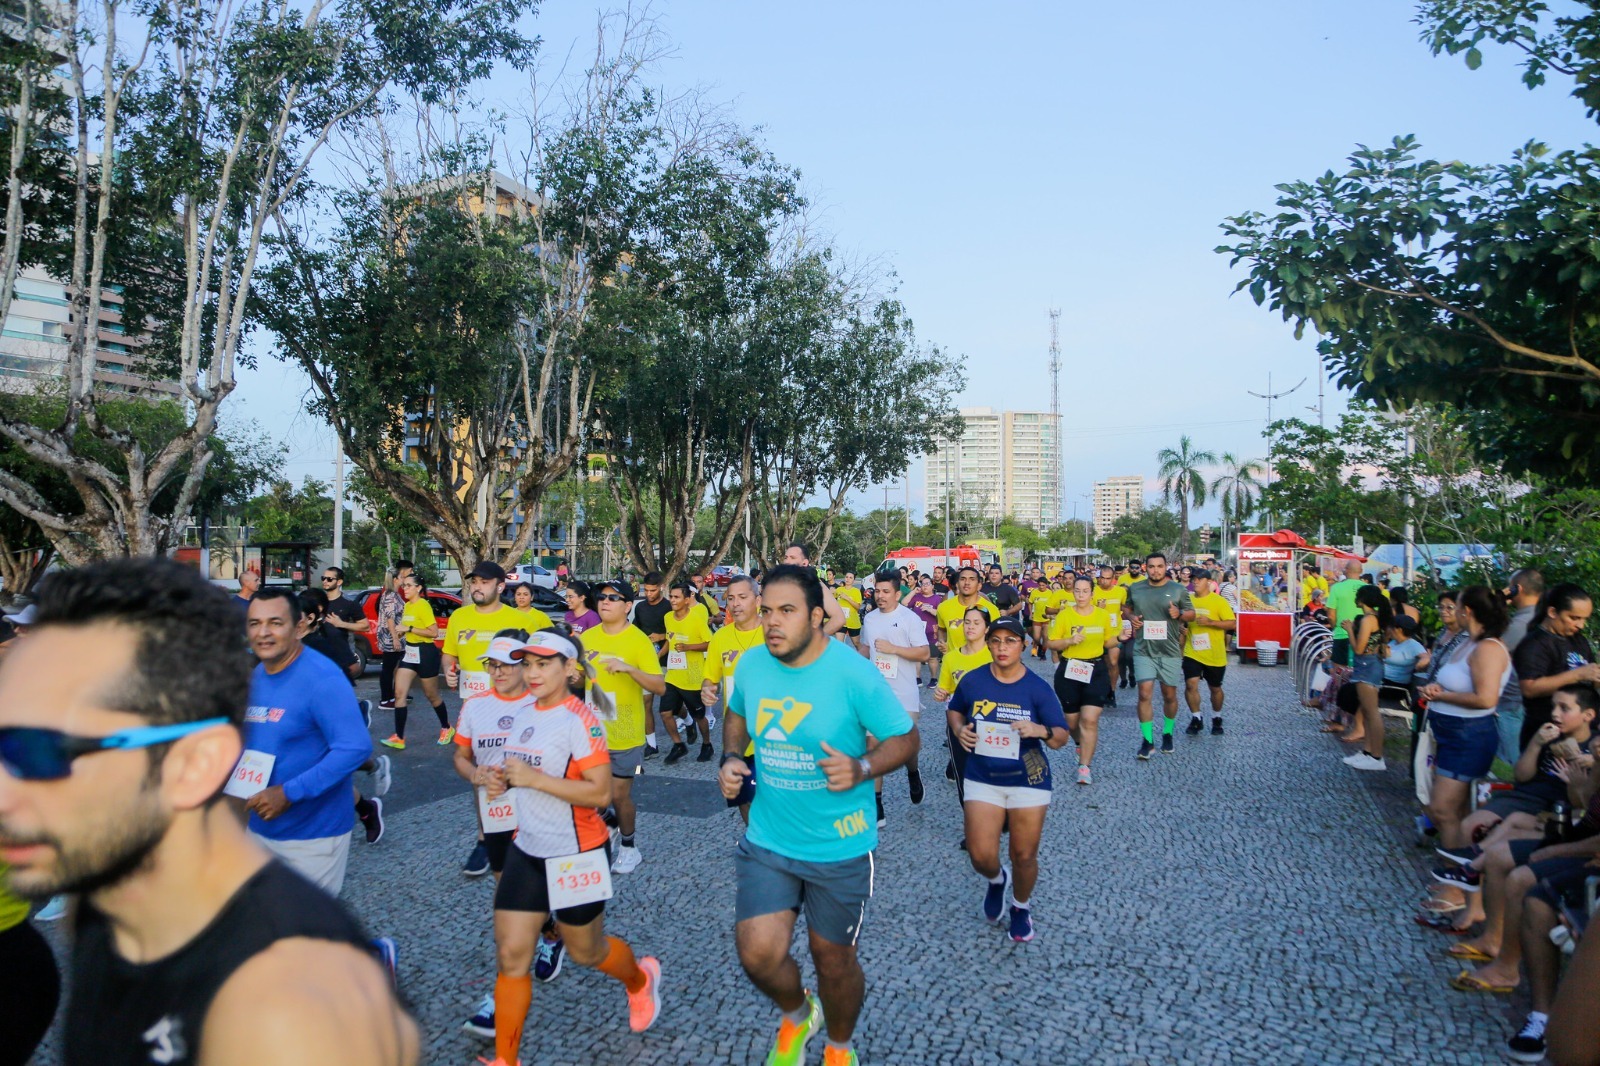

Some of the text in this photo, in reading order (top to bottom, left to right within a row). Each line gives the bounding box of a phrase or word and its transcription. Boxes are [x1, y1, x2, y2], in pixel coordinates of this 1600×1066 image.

[463, 681, 486, 691] 1428
[996, 706, 1022, 714] MANAUS
[996, 712, 1032, 721] MOVIMENTO
[984, 735, 1010, 747] 415
[760, 746, 814, 762] MANAUS EM
[761, 756, 816, 771] MOVIMENTO
[234, 767, 264, 784] 1914
[488, 804, 514, 818] 402
[833, 809, 870, 838] 10K
[557, 870, 602, 891] 1339
